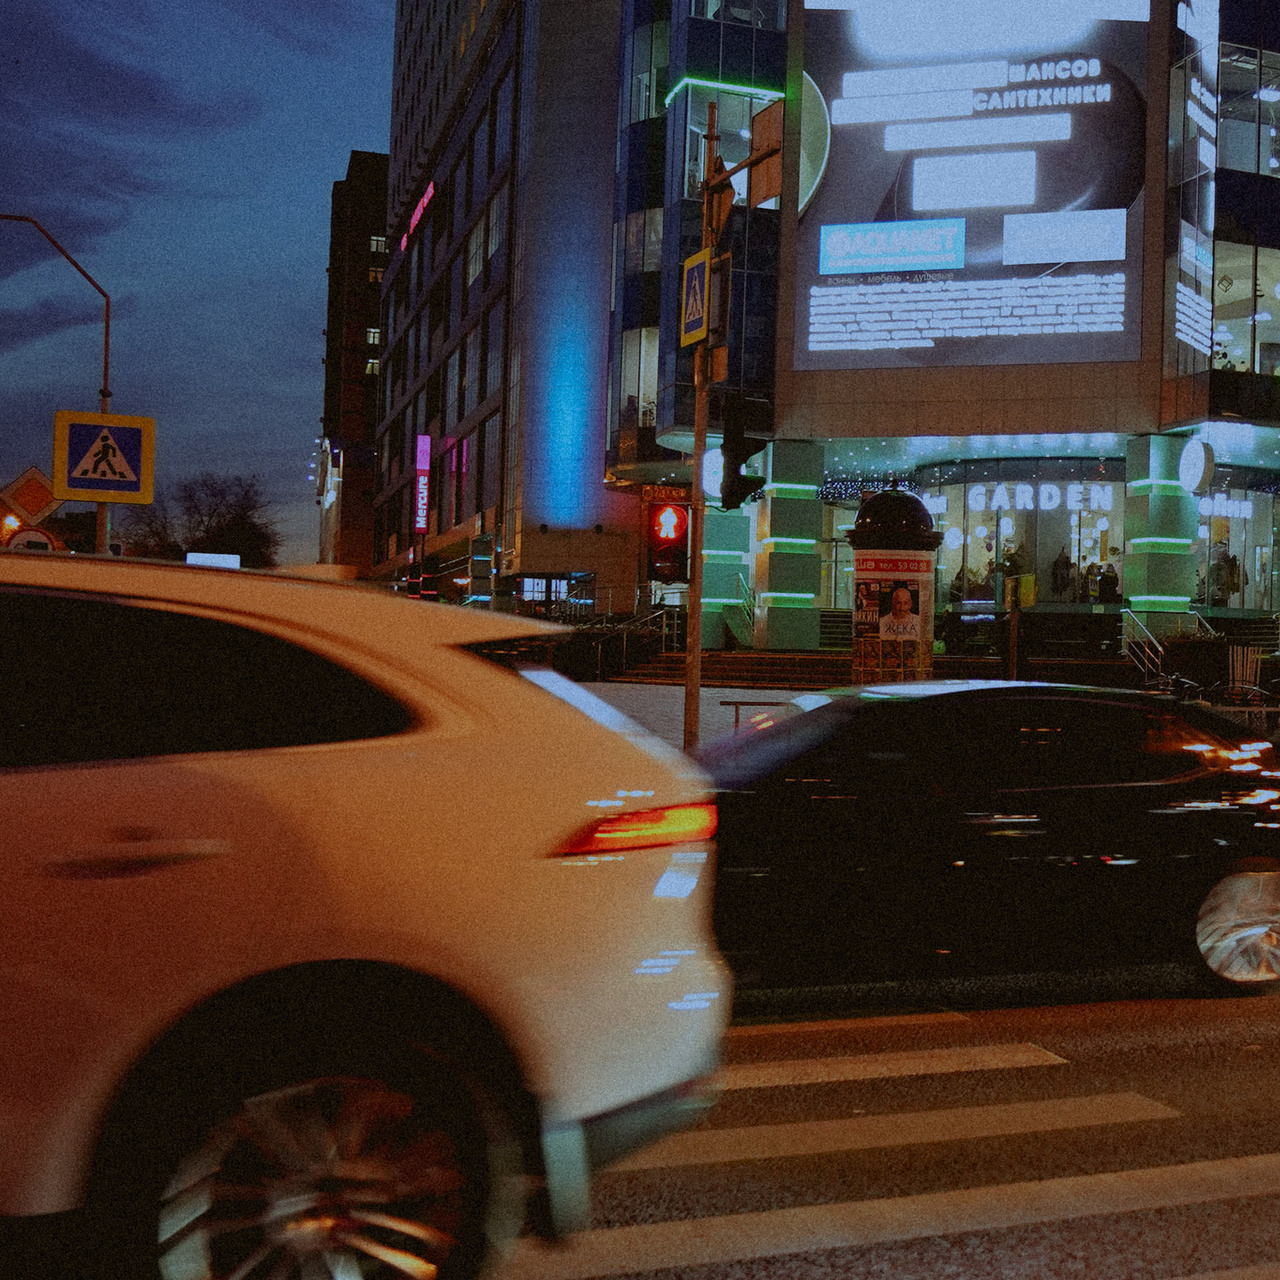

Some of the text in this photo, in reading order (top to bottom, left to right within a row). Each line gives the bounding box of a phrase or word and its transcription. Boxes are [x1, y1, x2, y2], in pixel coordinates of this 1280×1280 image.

[973, 84, 1111, 111] САНТЕХНИКИ
[416, 475, 428, 528] Mercure
[968, 483, 1113, 511] GARDEN
